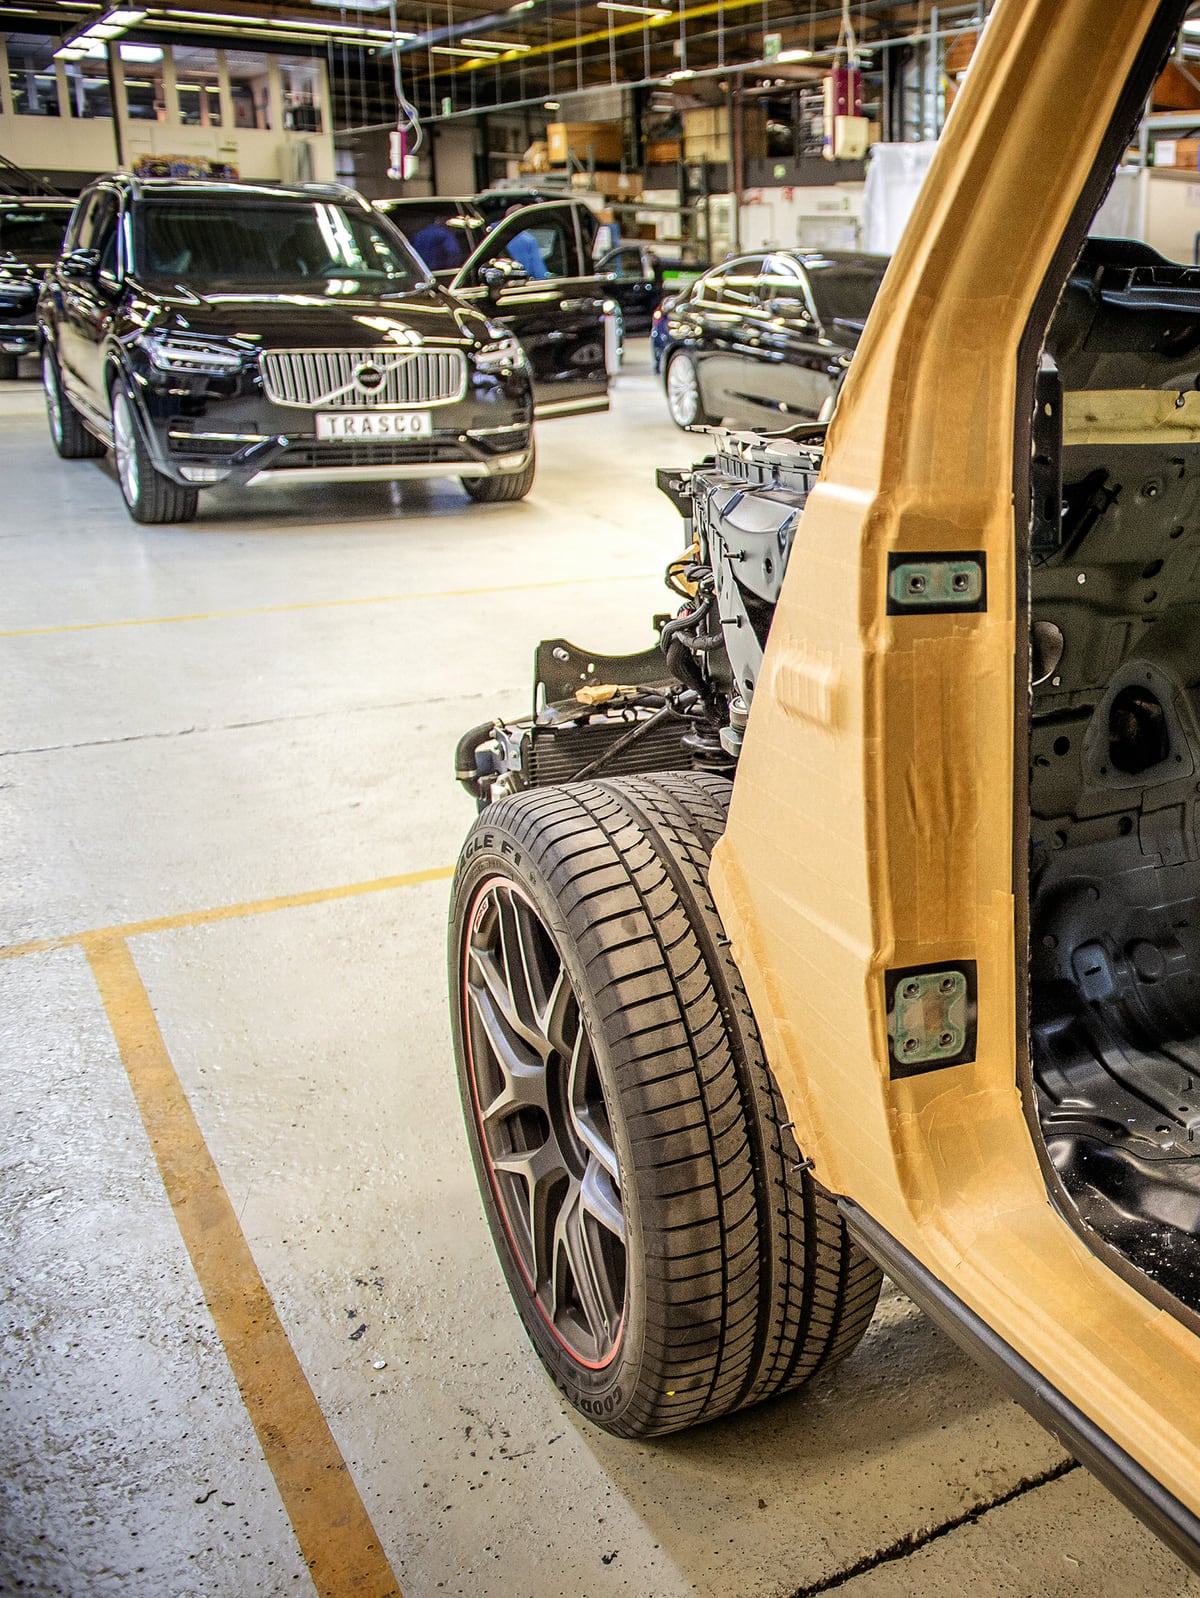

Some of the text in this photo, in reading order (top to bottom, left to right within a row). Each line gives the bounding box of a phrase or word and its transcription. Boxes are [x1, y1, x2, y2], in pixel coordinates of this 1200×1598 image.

[326, 415, 422, 435] TRASCO
[456, 834, 494, 891] AGLE
[501, 839, 522, 867] F1
